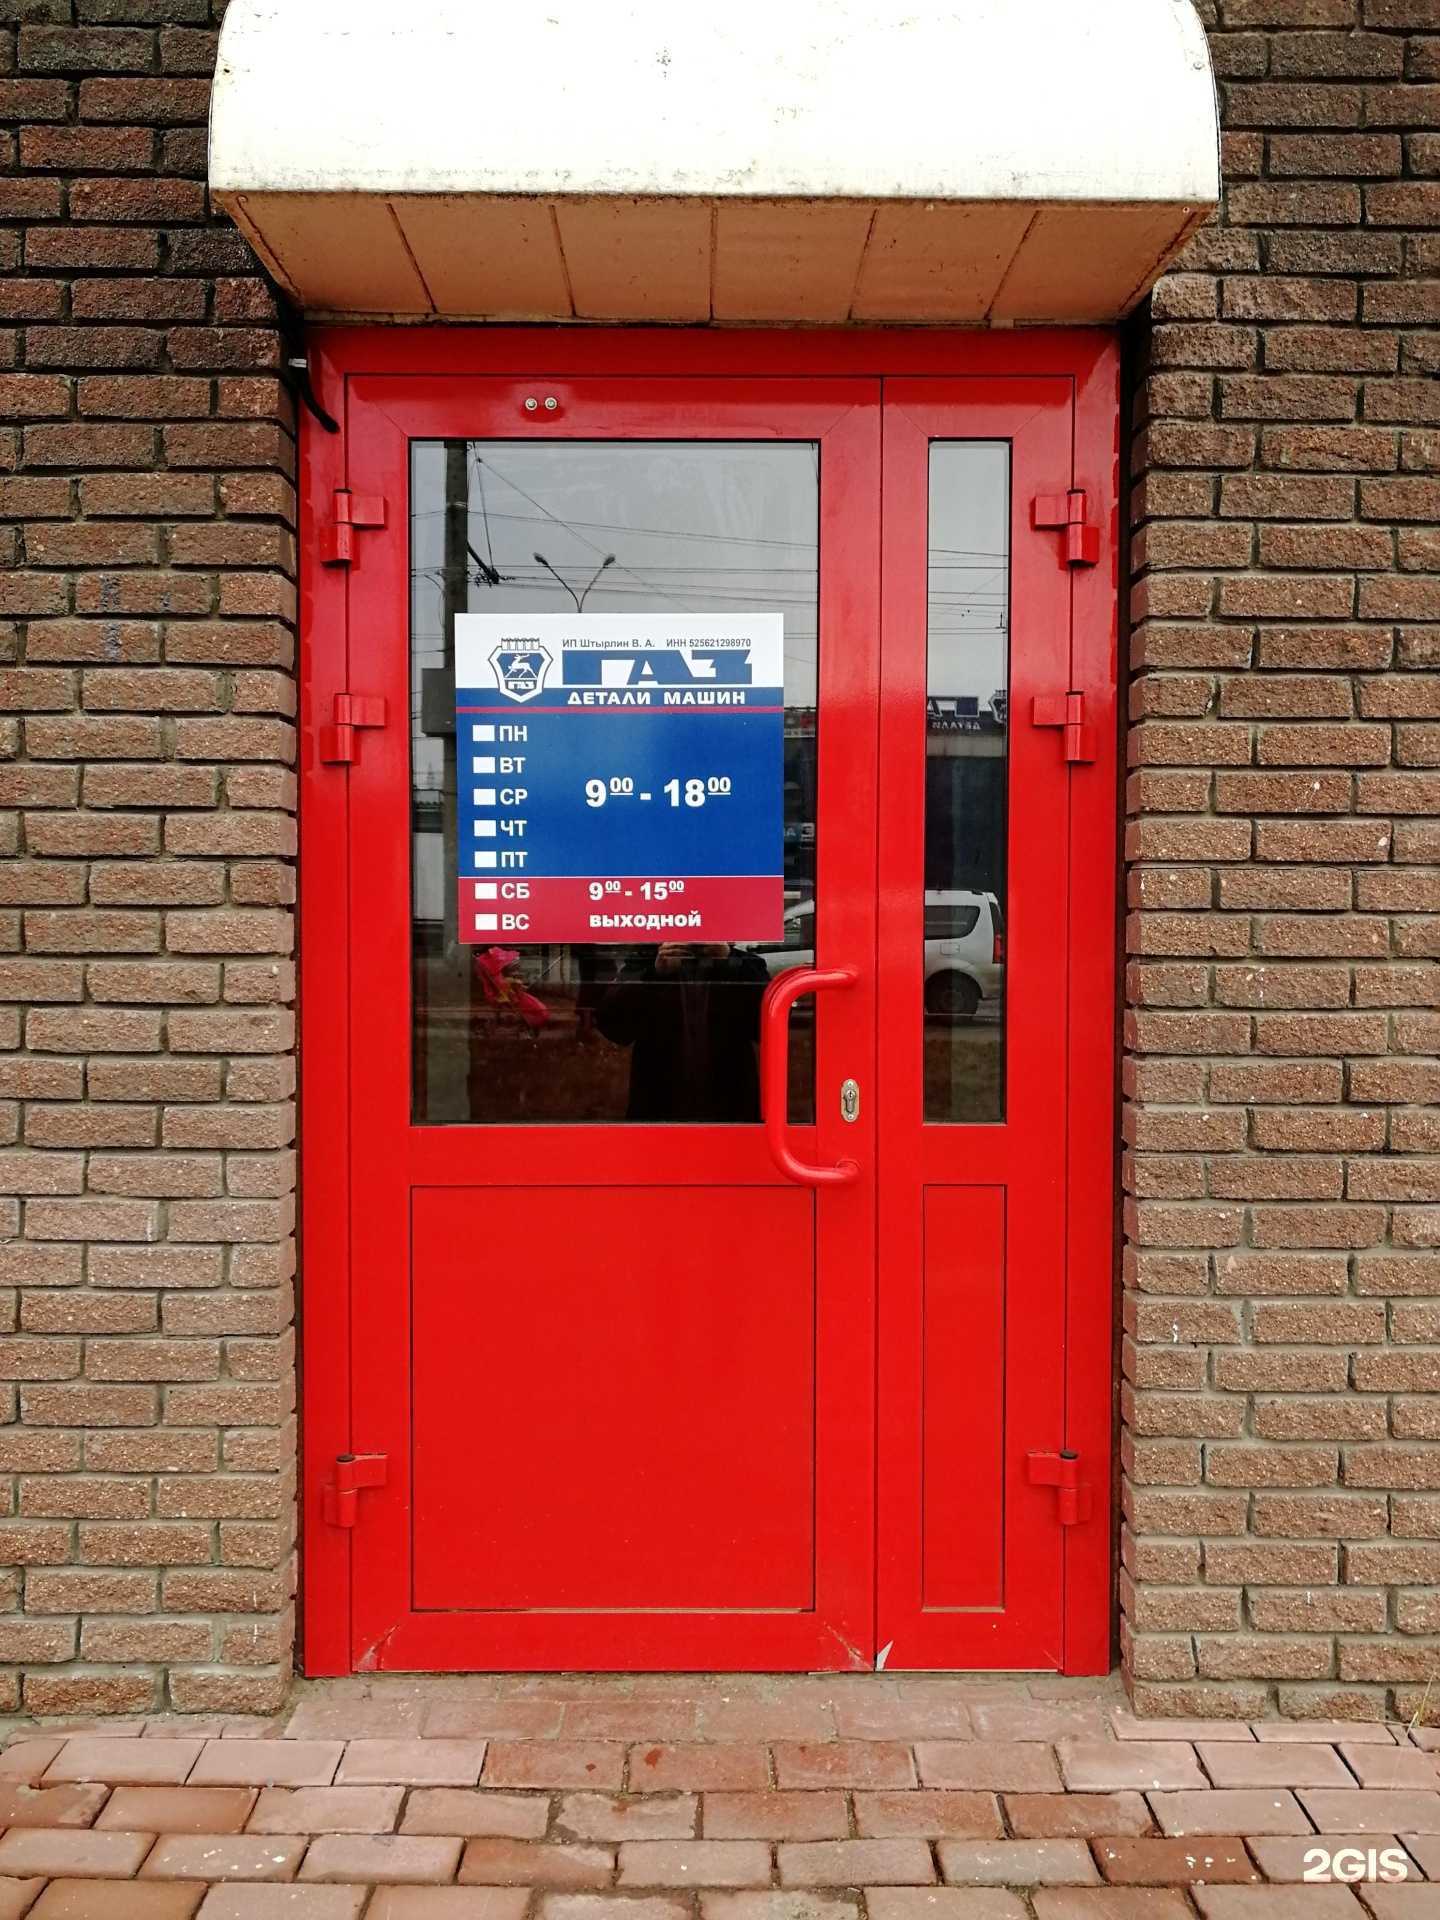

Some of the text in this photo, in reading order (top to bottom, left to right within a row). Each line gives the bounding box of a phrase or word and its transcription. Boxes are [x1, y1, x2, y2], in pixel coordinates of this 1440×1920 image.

[562, 638, 751, 650] ИП Штырлин В. А. ИНН 525621298970
[562, 649, 752, 685] ГАЗ
[567, 691, 746, 705] ДЕТАЛИ МАШИН
[499, 725, 528, 742] ПН
[499, 757, 527, 773] ВТ
[499, 788, 528, 805] СР
[500, 820, 528, 836] ЧТ
[500, 851, 528, 867] ПТ
[501, 882, 530, 899] СБ
[501, 914, 530, 930] ВС
[589, 910, 702, 930] выходной
